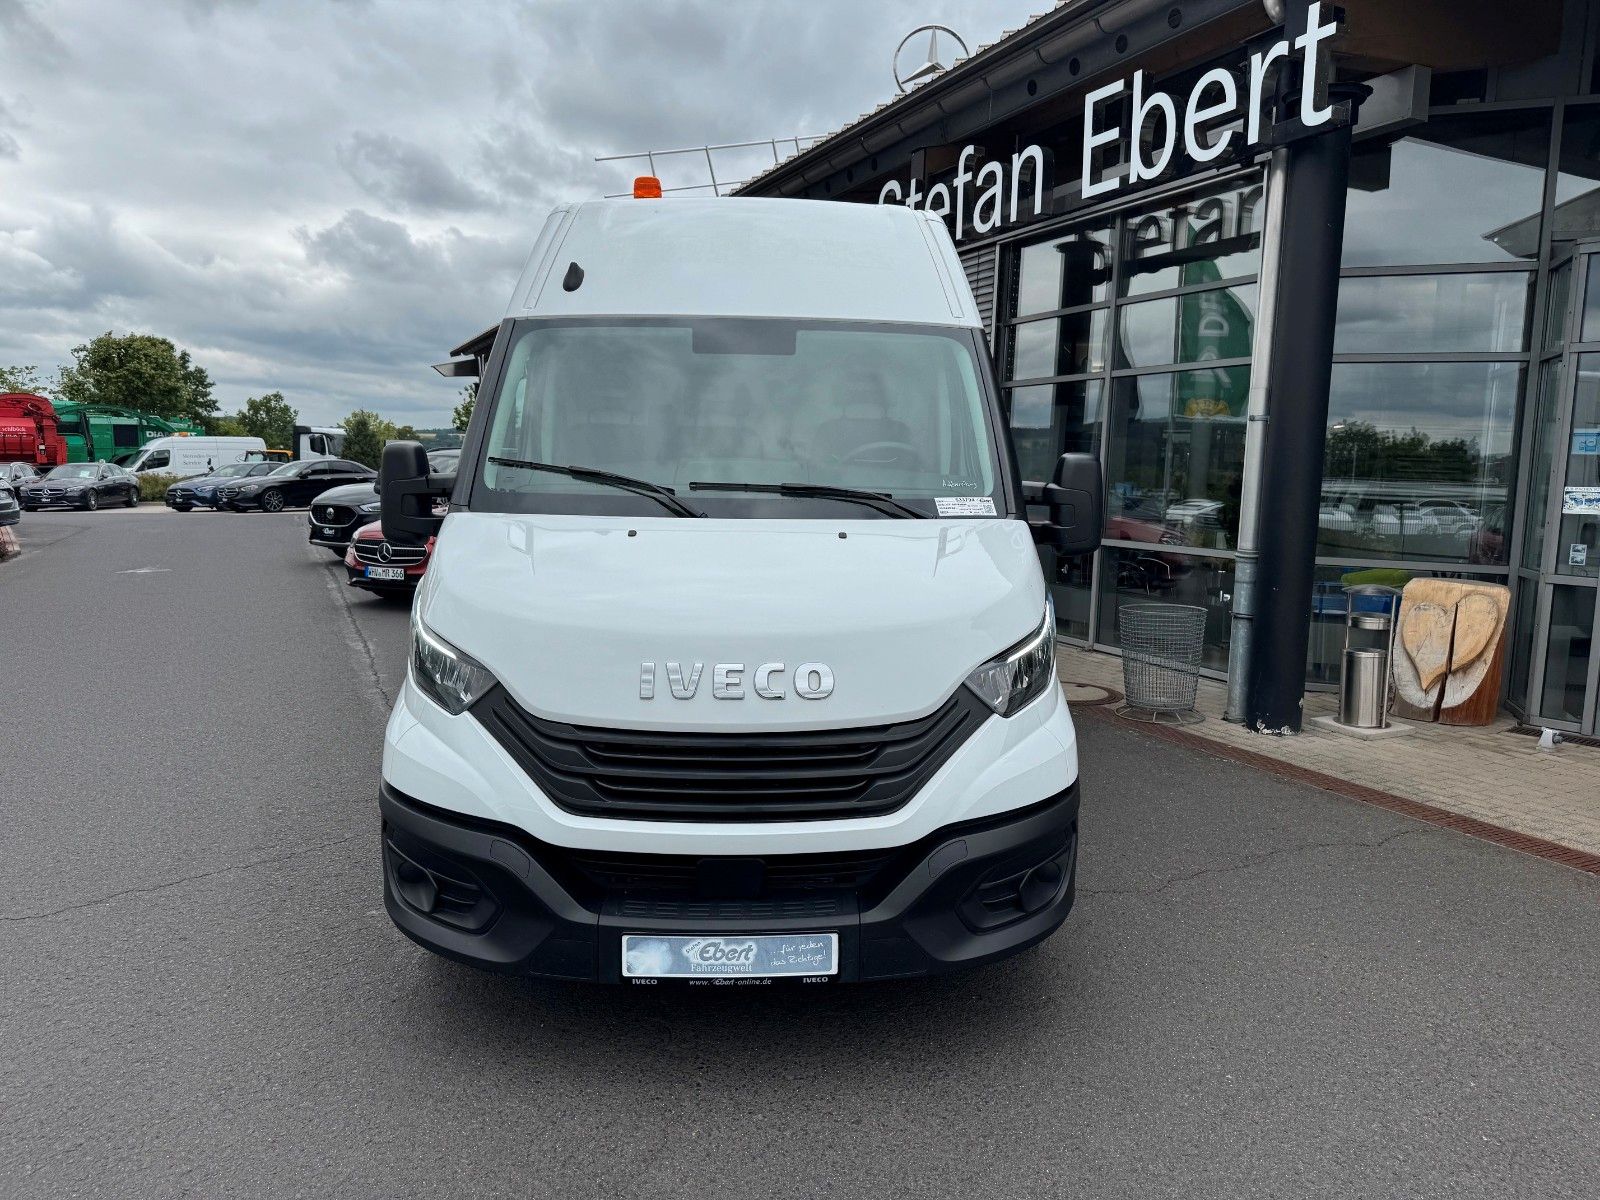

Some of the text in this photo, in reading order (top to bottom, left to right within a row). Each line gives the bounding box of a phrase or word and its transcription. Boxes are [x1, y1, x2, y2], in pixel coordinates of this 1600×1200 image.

[1081, 1, 1337, 199] Ebert
[391, 569, 404, 578] 366
[639, 662, 835, 700] IVECO
[699, 942, 754, 961] Ebert
[799, 941, 824, 952] jeden
[691, 963, 753, 973] Fahrzeugwelt
[802, 976, 829, 984] IVECO
